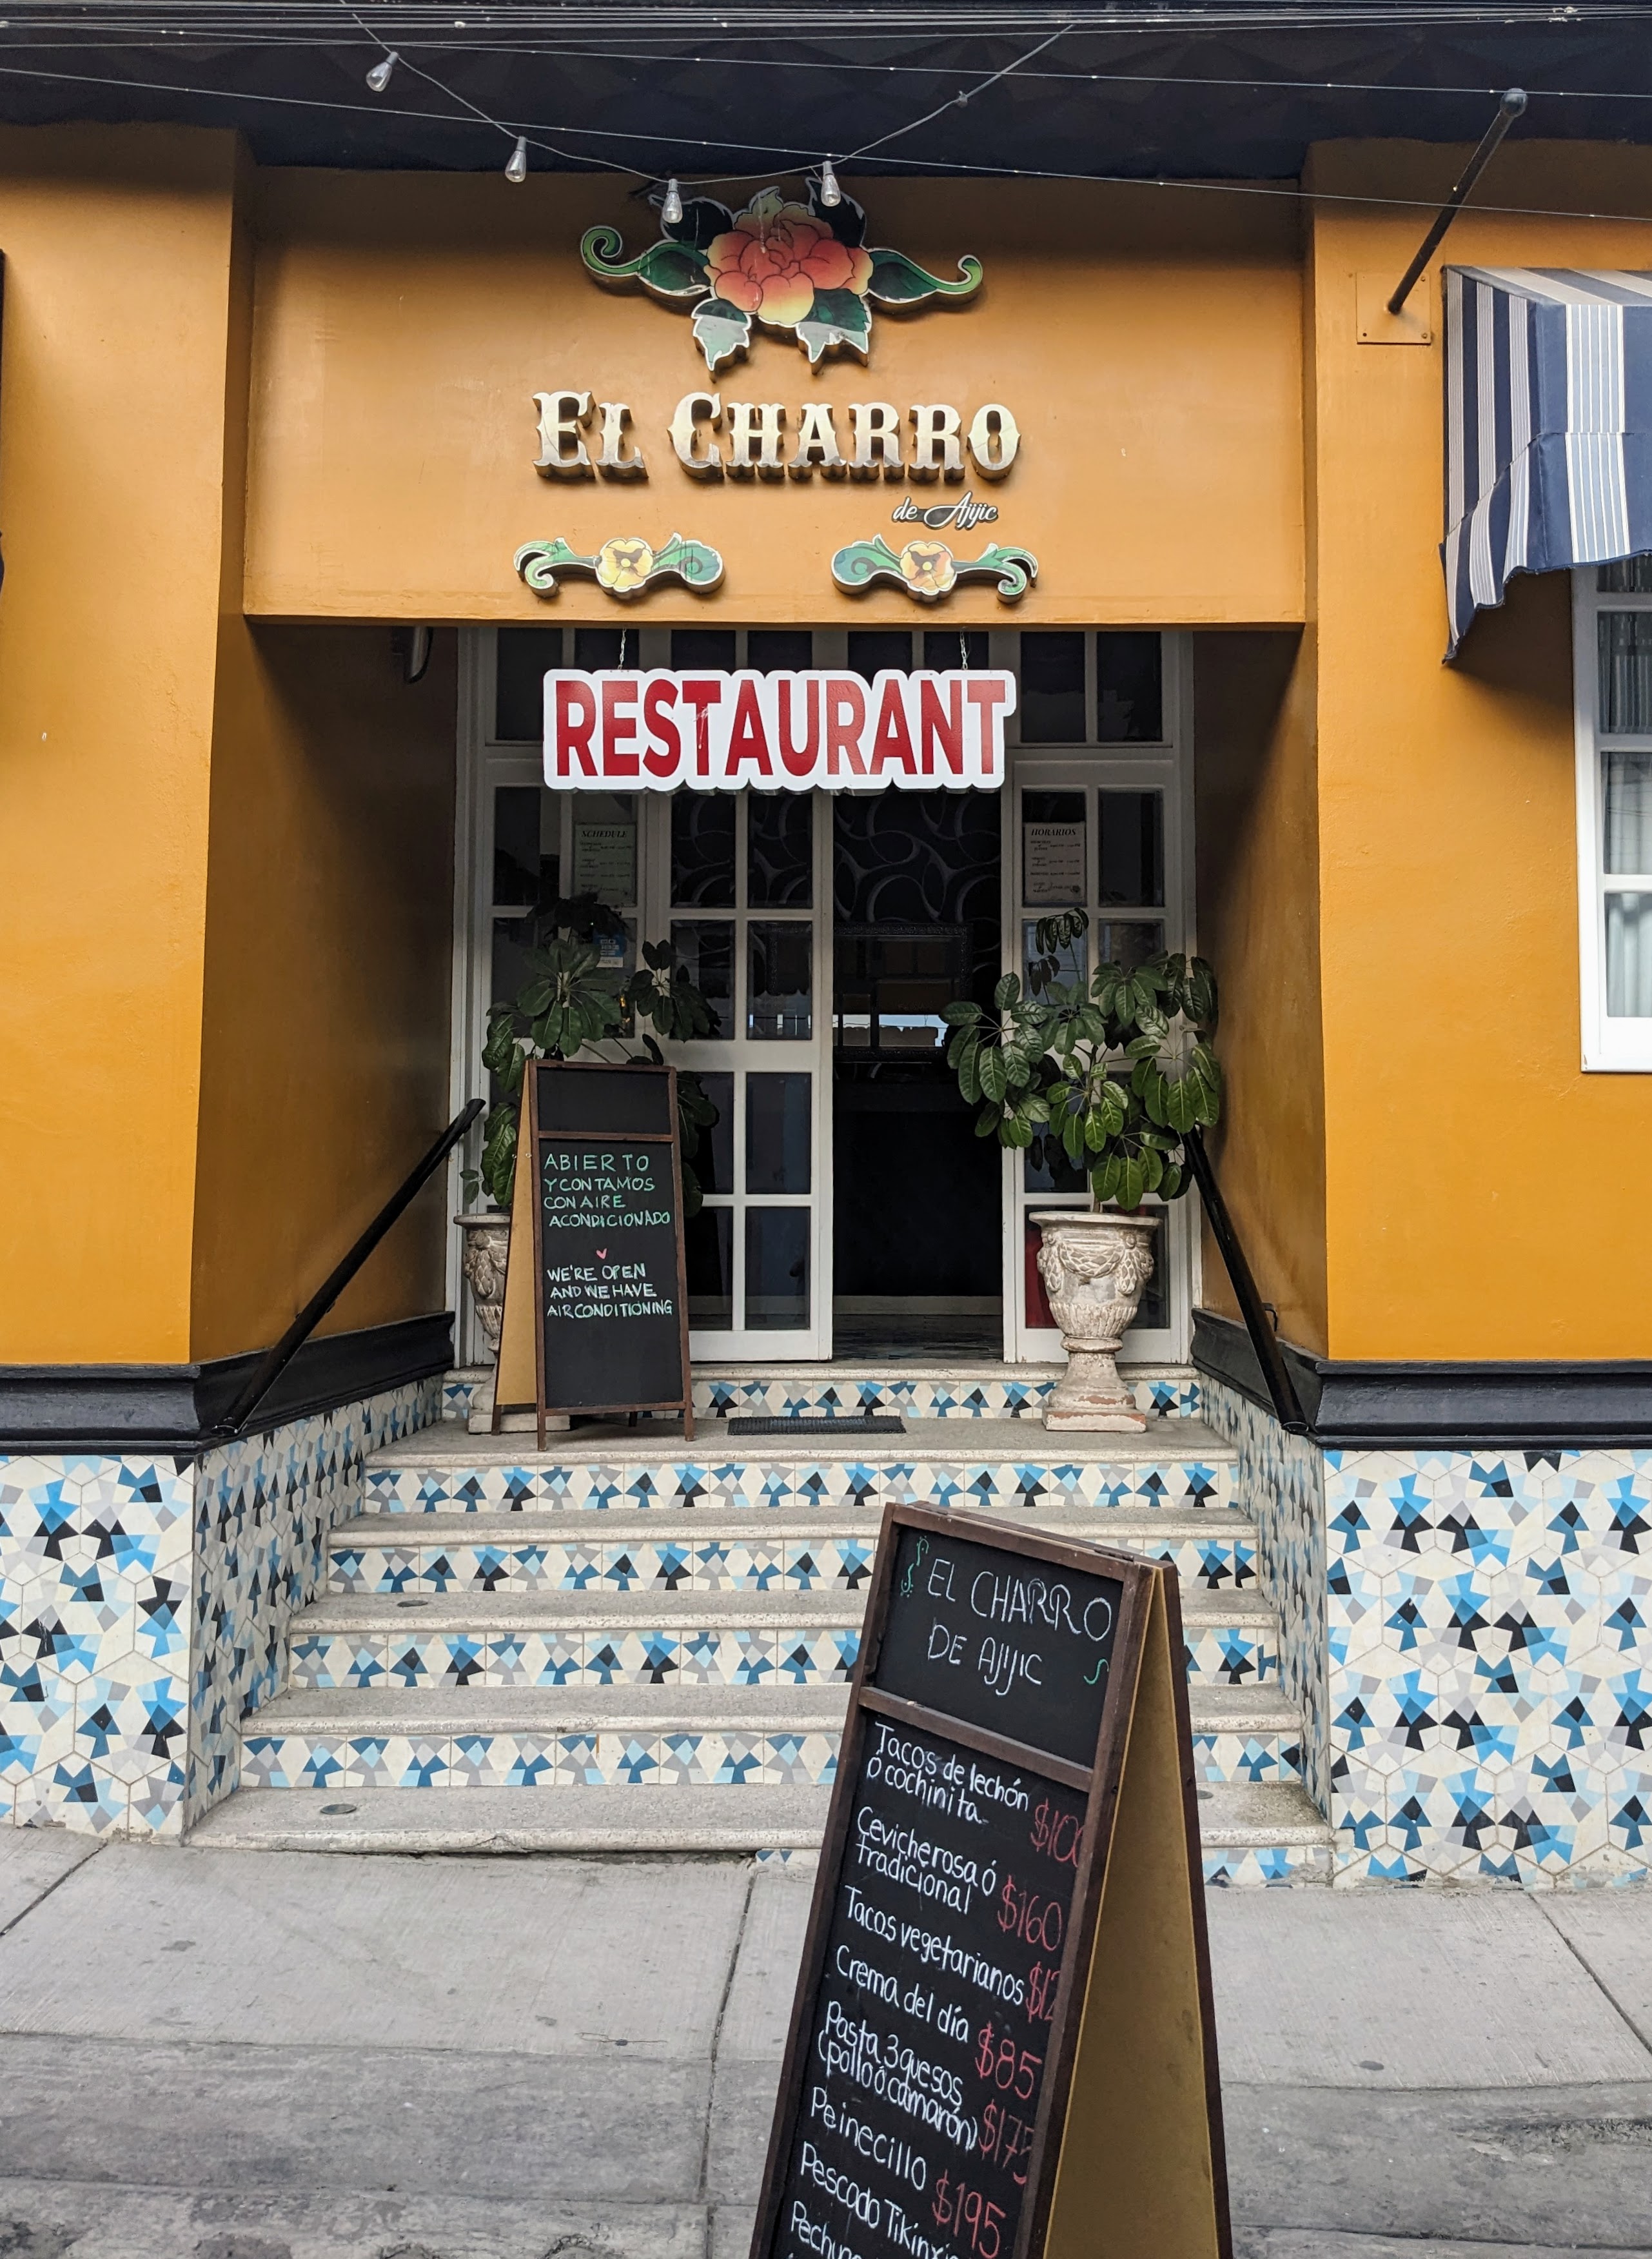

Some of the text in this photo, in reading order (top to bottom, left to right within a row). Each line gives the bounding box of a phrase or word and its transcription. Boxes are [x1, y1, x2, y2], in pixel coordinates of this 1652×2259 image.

[533, 391, 1021, 478] EL CHARRO
[892, 491, 998, 529] de Ajijic
[555, 679, 1006, 776] RESTAURANT
[582, 830, 628, 838] SCHEDULE
[544, 1153, 649, 1172] ABIERTO
[544, 1194, 626, 1210] CON AIRE
[549, 1210, 671, 1228] ACONDICIONADO
[546, 1263, 646, 1282] WE'RE OPEN
[550, 1283, 657, 1299] AND WE HAVE
[971, 1570, 1112, 1642] CHARRO
[874, 1722, 937, 1775] Tacos
[942, 1753, 965, 1785] de
[969, 1762, 1029, 1812] lechón
[845, 1884, 896, 1942] Tacos
[901, 1922, 1025, 2006] vegetarianos
[997, 1874, 1063, 1952] $160
[825, 2000, 881, 2064] Pasta
[836, 1944, 900, 2008] Crema
[904, 1983, 934, 2023] del
[974, 2020, 1043, 2101] $85
[800, 2140, 881, 2229] Pescado
[932, 2169, 1007, 2259] $195
